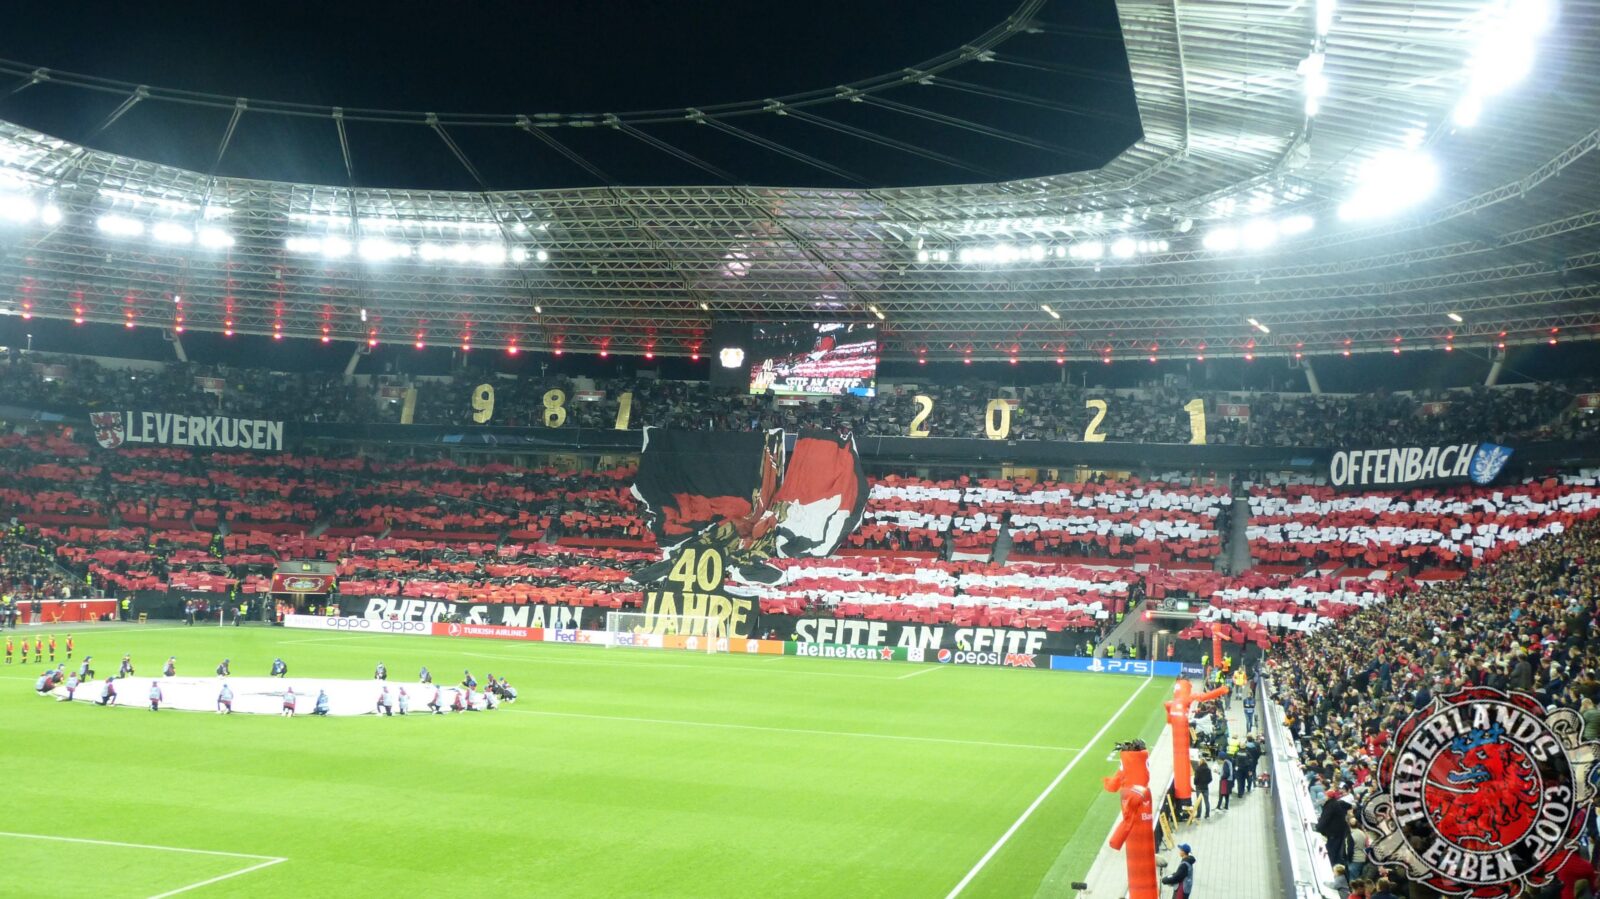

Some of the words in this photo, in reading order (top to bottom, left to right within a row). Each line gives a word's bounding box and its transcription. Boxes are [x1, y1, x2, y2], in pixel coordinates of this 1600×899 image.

[126, 411, 284, 450] LEVERKUSEN
[1330, 443, 1478, 486] OFFENBACH
[668, 548, 722, 592] 40
[327, 618, 370, 629] oppo
[502, 604, 585, 630] MAIN
[634, 591, 752, 639] JAHRE
[381, 621, 425, 632] oppo
[464, 627, 494, 636] TURKISH
[495, 629, 527, 638] AIRLINES
[555, 629, 592, 643] FedEx
[795, 618, 888, 646] SEITE
[897, 626, 944, 649] AN
[954, 628, 1047, 654] SEITE
[796, 642, 877, 660] Heineken
[954, 651, 1000, 666] pepsi
[1003, 652, 1037, 668] MAX
[1107, 660, 1148, 673] PS5
